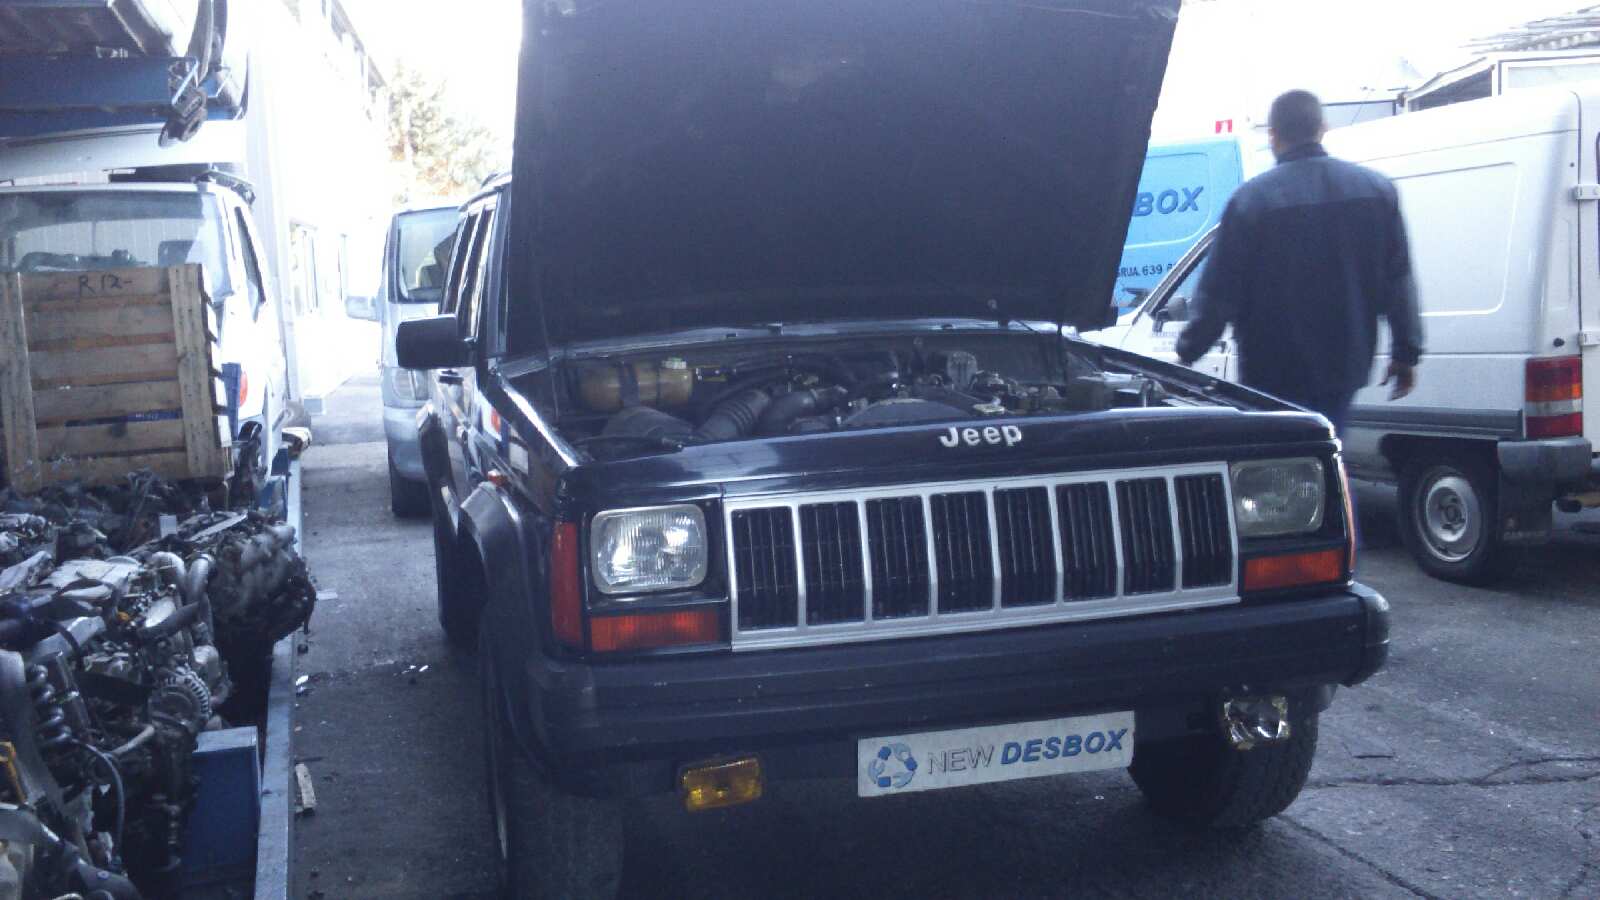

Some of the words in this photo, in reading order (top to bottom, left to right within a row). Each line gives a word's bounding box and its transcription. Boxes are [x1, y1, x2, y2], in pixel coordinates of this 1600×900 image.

[939, 425, 1022, 447] Jeep
[927, 745, 994, 774] NEW
[1000, 728, 1128, 765] DESBOX
